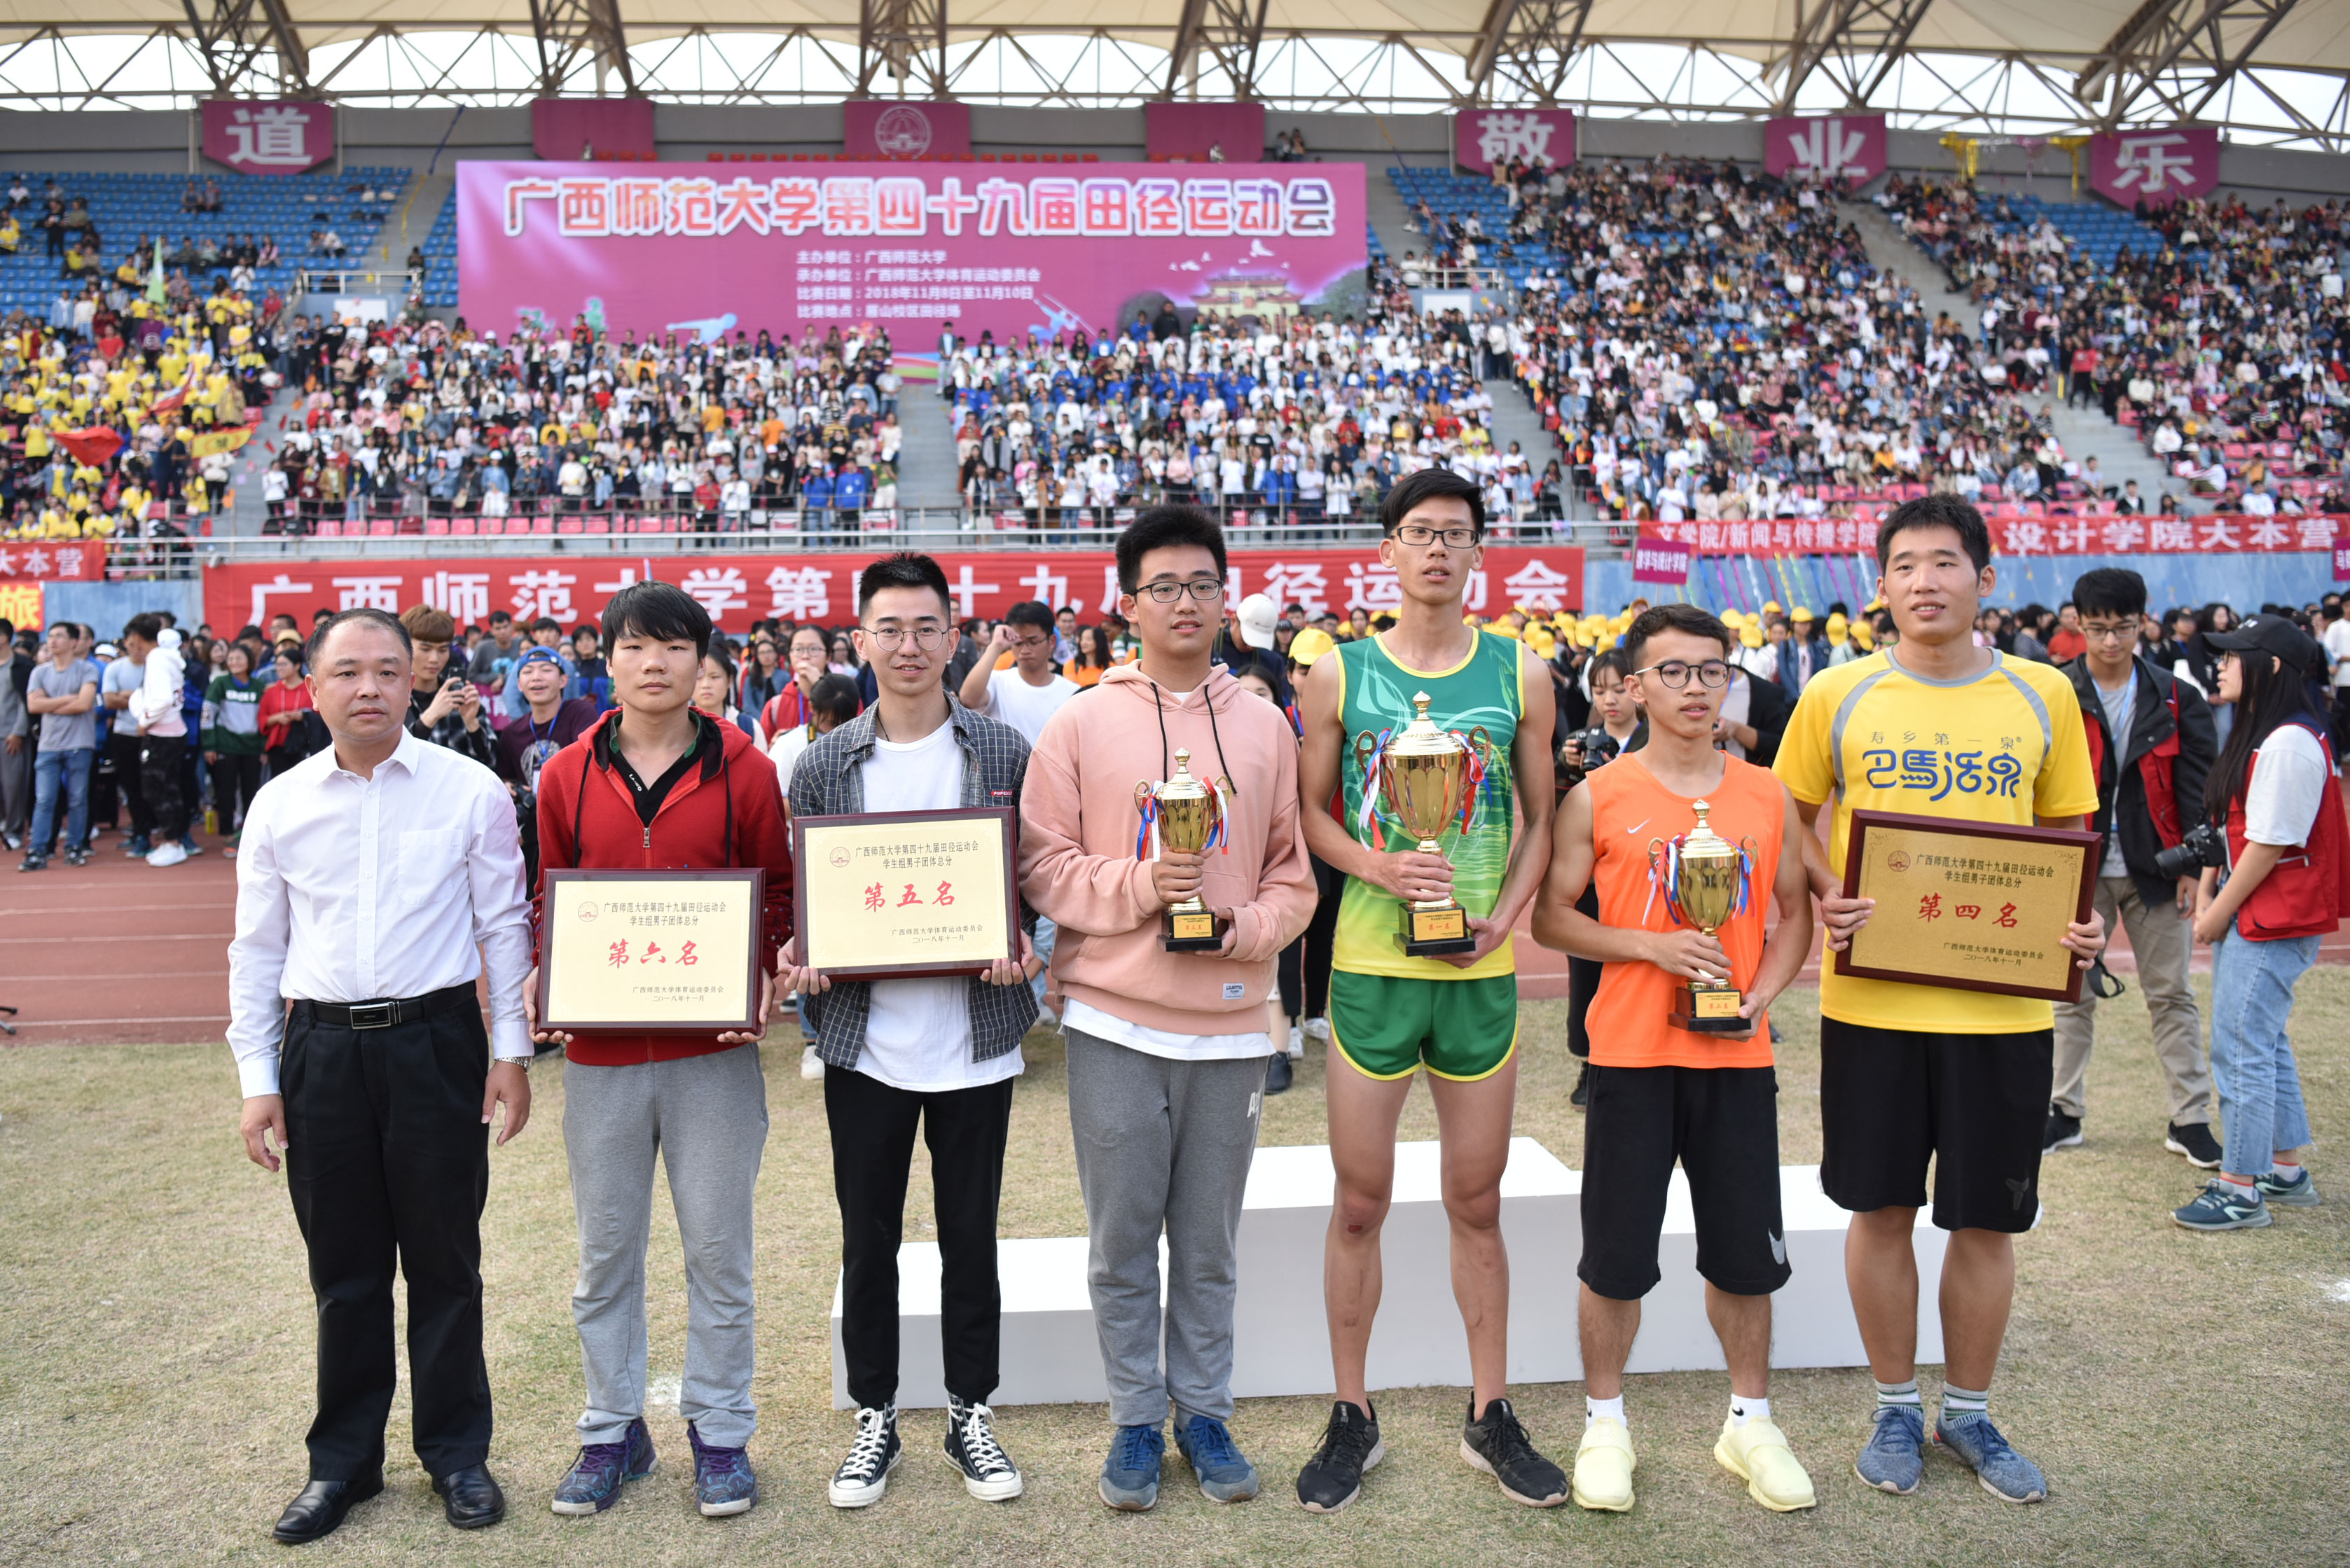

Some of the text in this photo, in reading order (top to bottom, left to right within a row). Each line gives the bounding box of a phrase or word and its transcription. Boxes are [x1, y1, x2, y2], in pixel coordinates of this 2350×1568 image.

[226, 106, 312, 167] 道
[1477, 113, 1556, 167] 敬
[1788, 119, 1867, 177] 业
[2111, 133, 2197, 193] 乐
[504, 176, 1336, 237] 广西师范大学第四十九届田径运动会
[2003, 518, 2339, 552] 设计学院大本营
[1871, 730, 2014, 750] 寿乡第一泉
[855, 840, 979, 858] 广西师范大学第四十九届田径运动会
[883, 855, 953, 870] 学生组男子团体总分
[1916, 853, 2054, 878] 广西师范大学第四十九届田径运动会
[1944, 870, 2022, 889] 学生组男子团体总分
[603, 901, 727, 913] 广西师范大学第四十九届田径运动会
[864, 880, 955, 913] 第五名
[630, 915, 699, 927] 学生组男子团体总分
[1917, 892, 2018, 929] 第四名
[891, 924, 983, 936] 广西师范大学体育运动委员会
[607, 938, 699, 969] 第六名
[1943, 941, 2045, 960] 广西师范大学体育运动委员会
[633, 985, 724, 994] 广西师范大学体育运动委员会
